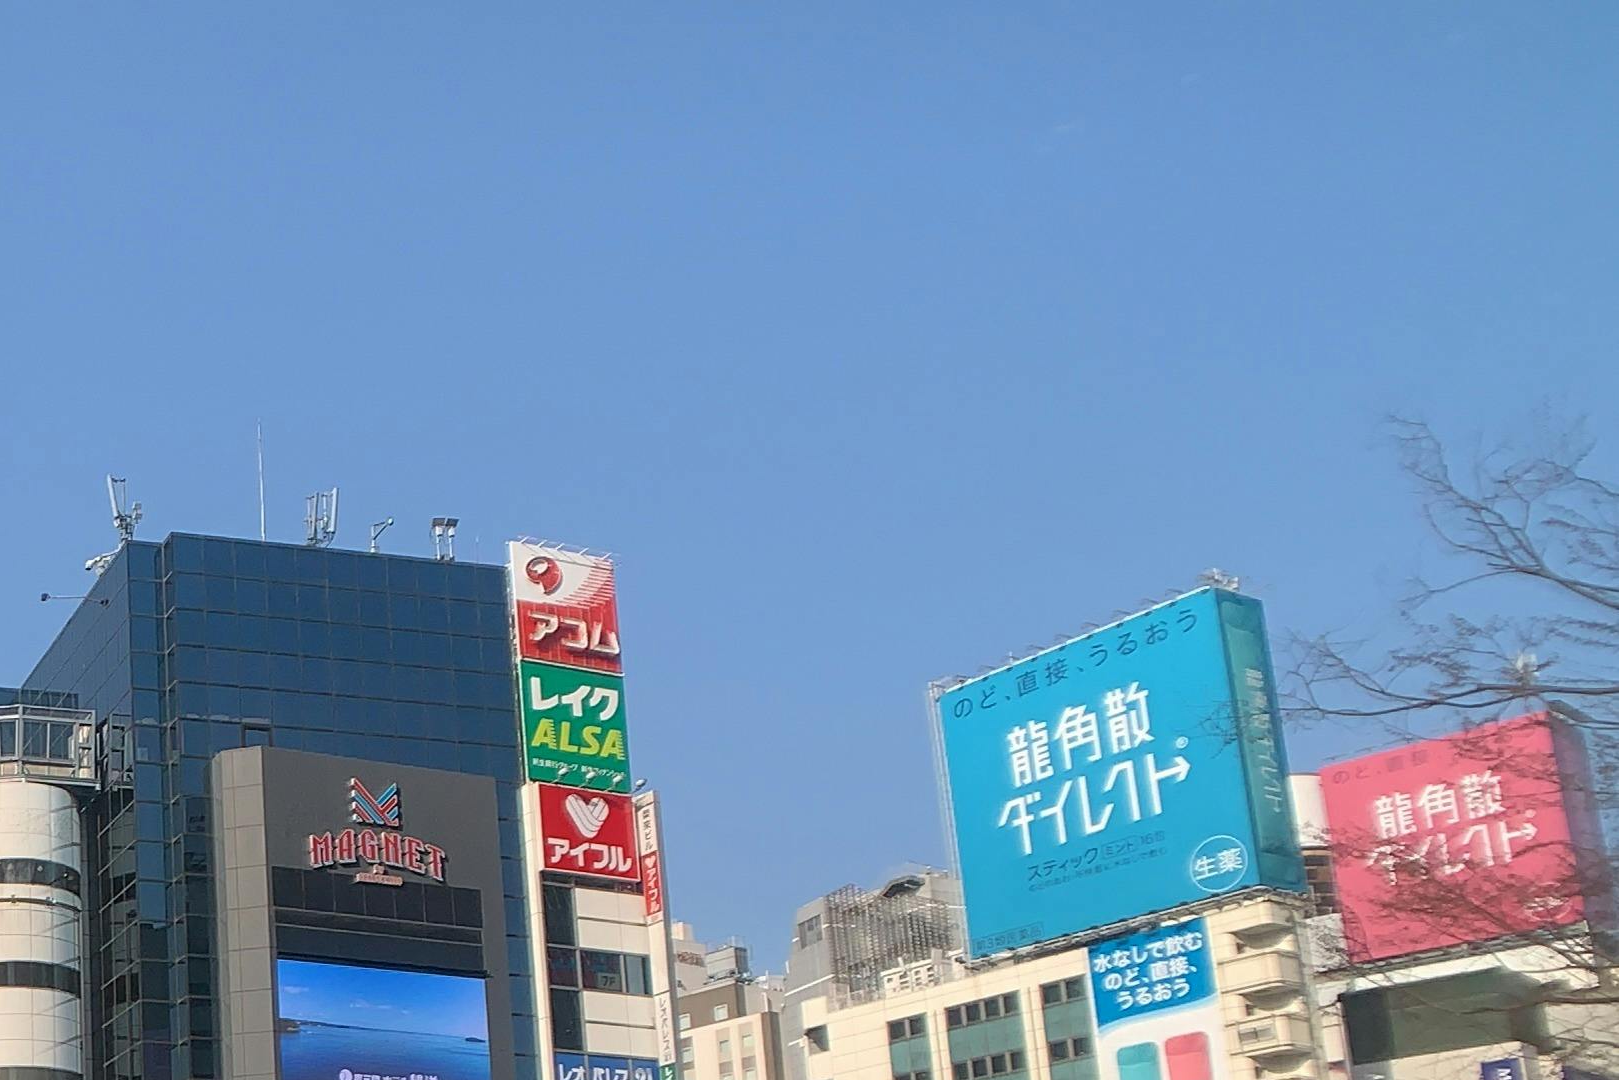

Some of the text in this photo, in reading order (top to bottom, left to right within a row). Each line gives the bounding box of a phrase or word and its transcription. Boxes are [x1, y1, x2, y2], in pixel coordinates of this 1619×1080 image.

[528, 611, 621, 656] アコム
[530, 677, 619, 721] レイク
[533, 718, 626, 760] ALSA
[1006, 682, 1154, 788] 龍角散
[997, 752, 1191, 856] ダイレクト
[1374, 769, 1506, 840] 龍角散
[309, 829, 446, 882] MAGNET
[548, 837, 632, 874] アイフル
[1028, 848, 1098, 881] スティック
[1194, 847, 1244, 881] 生薬
[646, 868, 662, 914] アイフル
[1093, 932, 1203, 973] 水なしで飲む
[1103, 956, 1197, 991] のど、直接、
[1117, 978, 1190, 1011] うるおう
